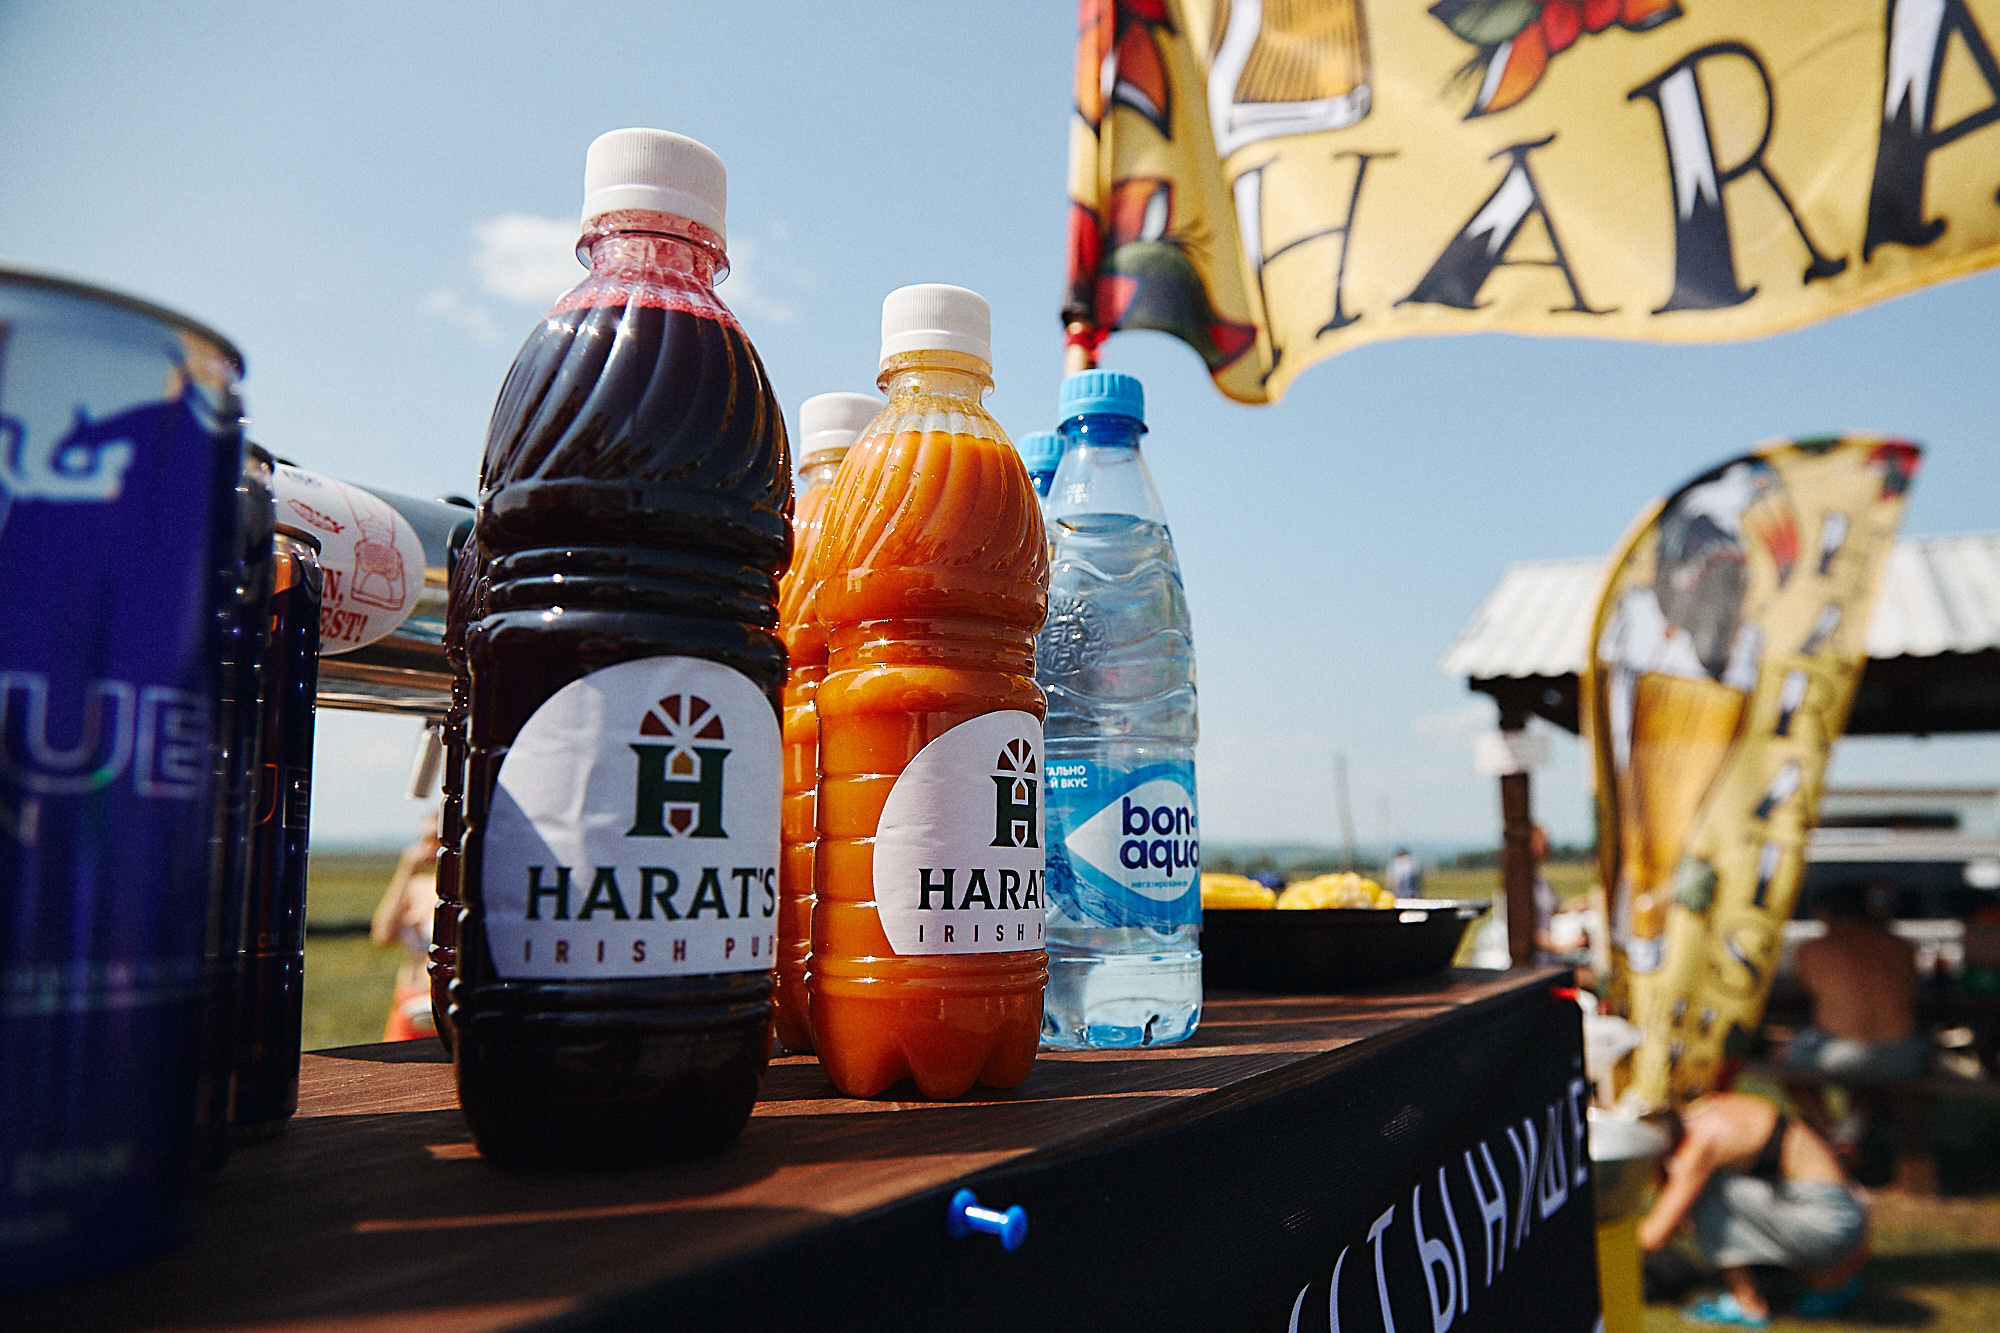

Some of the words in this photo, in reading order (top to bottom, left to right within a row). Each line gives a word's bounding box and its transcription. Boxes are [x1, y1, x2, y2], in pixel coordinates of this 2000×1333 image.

[1061, 777, 1089, 788] ВКУС
[525, 865, 775, 921] HARAT'S
[919, 923, 1025, 943] IRISH
[523, 939, 687, 964] IRISH
